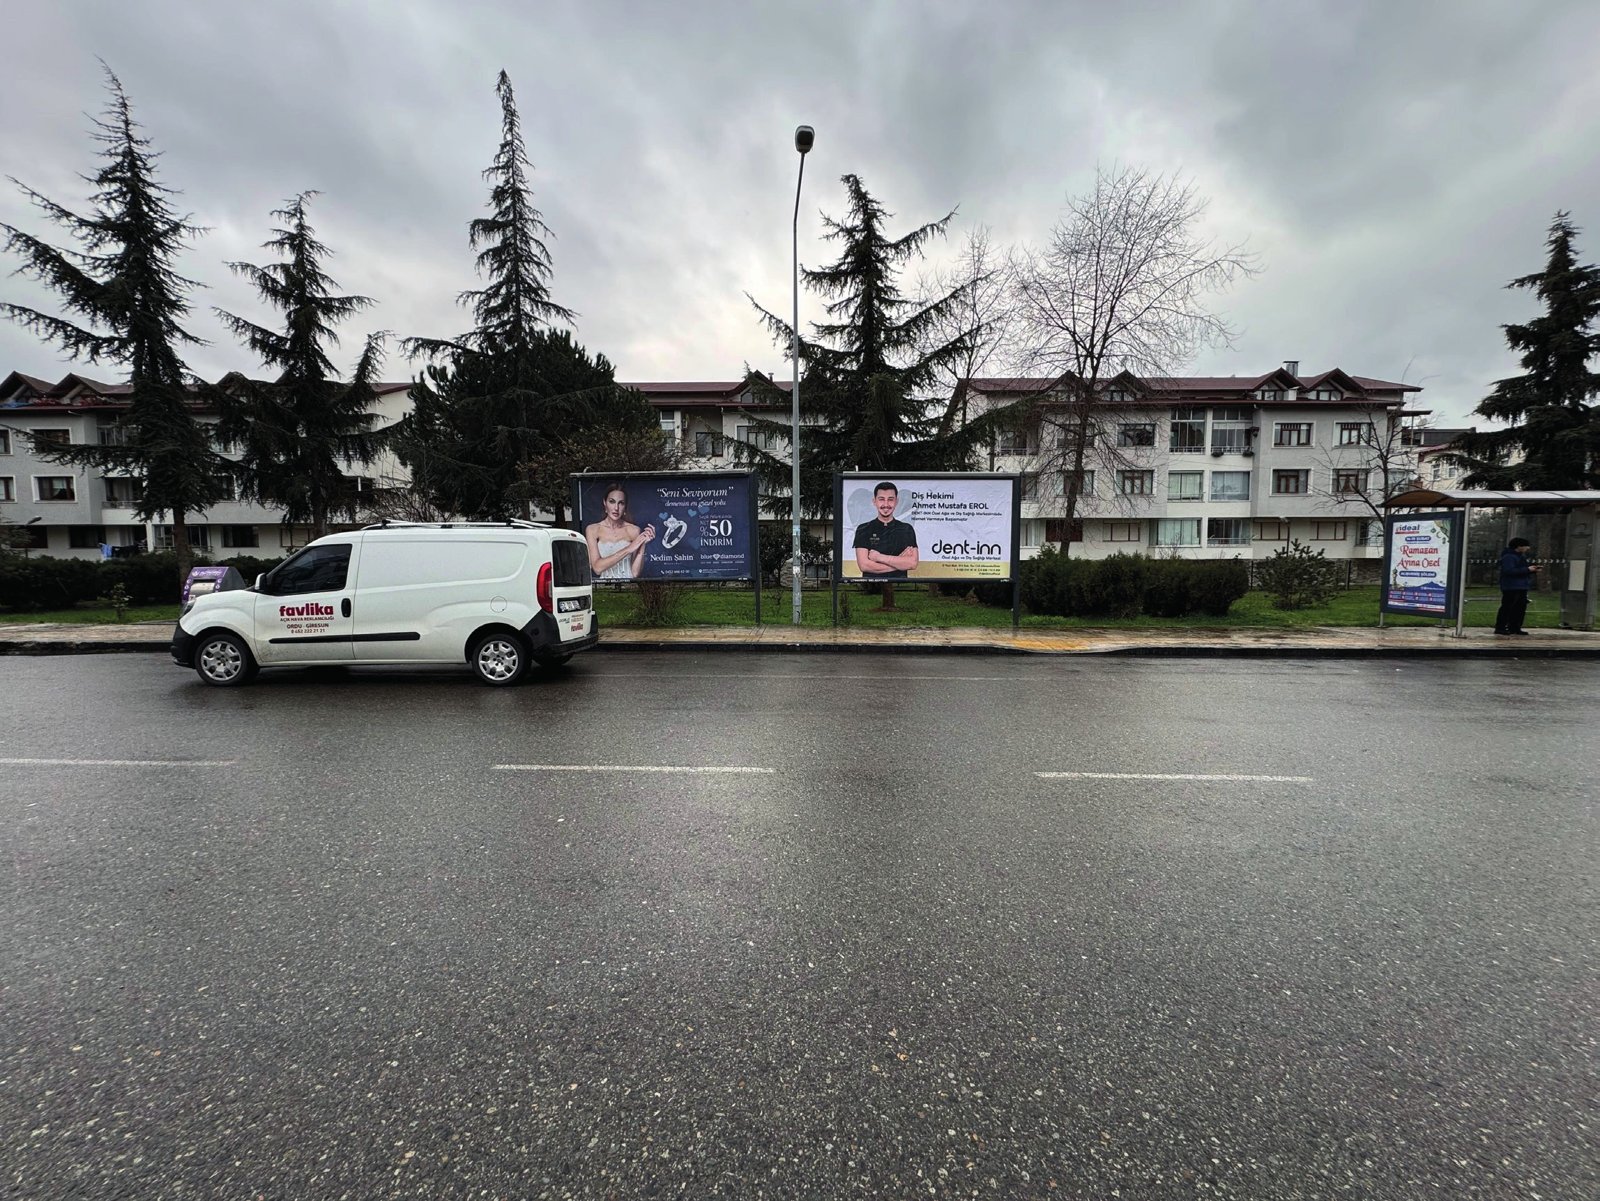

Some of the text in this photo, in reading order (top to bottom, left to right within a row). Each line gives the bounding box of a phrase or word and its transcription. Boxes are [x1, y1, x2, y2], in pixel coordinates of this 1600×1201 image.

[911, 492, 925, 500] Diş
[714, 498, 726, 508] yolu
[700, 537, 733, 546] İNDİRİM
[932, 539, 1002, 555] dent-inn
[1400, 545, 1438, 558] Ramazan
[650, 553, 694, 562] Nedim Şahin
[279, 603, 334, 616] favlika
